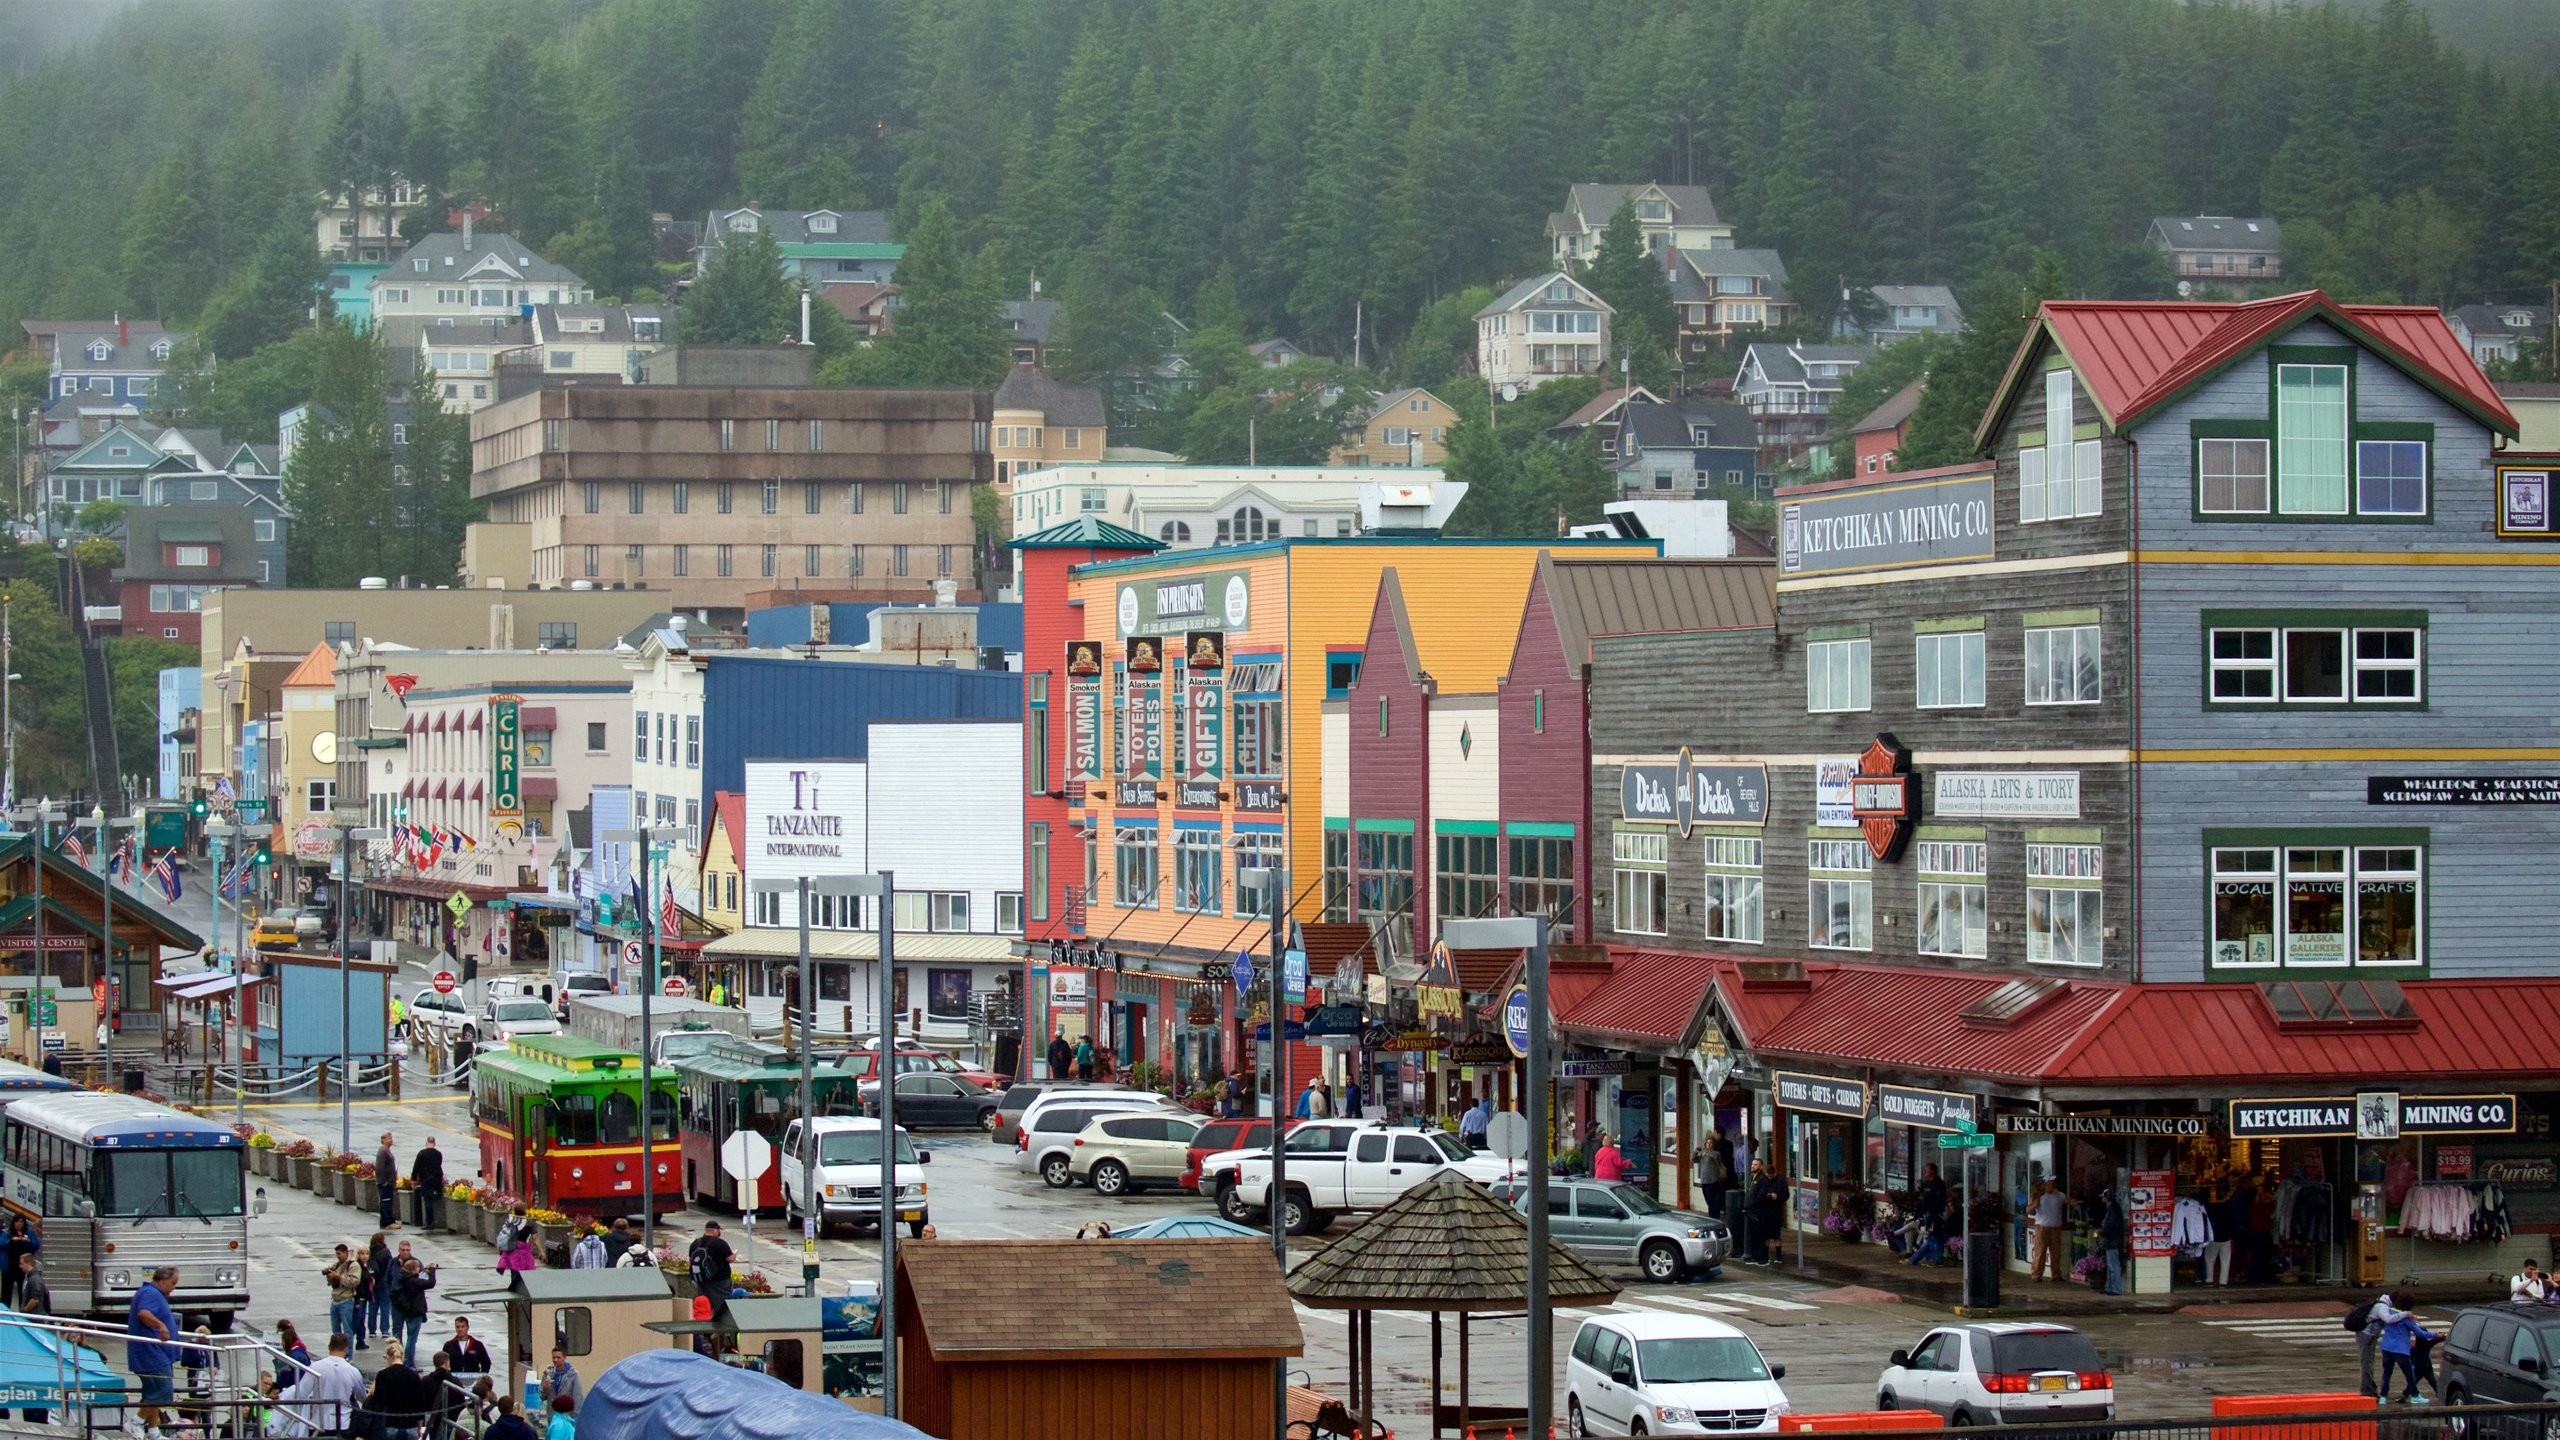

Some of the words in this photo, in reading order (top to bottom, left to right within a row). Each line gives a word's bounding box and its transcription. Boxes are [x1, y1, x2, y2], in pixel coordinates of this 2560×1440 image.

[1803, 511, 1893, 554] KETCHIKAN
[1899, 503, 1960, 544] MINING
[1965, 500, 1988, 536] CO.
[1070, 684, 1100, 692] Smoked
[1129, 681, 1161, 689] Alaskan
[1189, 677, 1223, 687] Alaskan
[399, 686, 405, 695] 2
[1076, 695, 1095, 769] SALMON
[1131, 697, 1145, 763] TOTEM
[1146, 699, 1160, 761] POLES
[1195, 690, 1217, 768] GIFTS
[500, 715, 515, 809] CURIO
[1820, 761, 1855, 787] FISHING
[1678, 772, 1691, 803] and
[1737, 775, 1744, 787] OF
[2403, 779, 2478, 790] WHALEBONE
[2494, 779, 2560, 790] SOAPSTONE
[1740, 788, 1757, 800] BEVERLY
[1940, 779, 1986, 799] ALASKA
[1991, 779, 2022, 799] ARTS
[2025, 781, 2034, 799] &
[2038, 779, 2075, 800] IVORY
[2383, 791, 2452, 801] SCRIMSHAW
[2469, 791, 2525, 801] ALASKAN
[1748, 801, 1760, 812] HILLS
[1818, 809, 1830, 820] MAIN
[1831, 810, 1854, 821] ENTRAN
[766, 815, 842, 836] TANZANITE
[766, 843, 842, 857] INTERNATIONAL
[1920, 844, 1986, 873] NATIVE
[2030, 847, 2101, 876] CRAFTS
[2215, 882, 2273, 895] LOCAL
[2289, 881, 2344, 894] NATIVE
[2359, 881, 2415, 894] CRAFTS
[47, 938, 85, 948] CENTER
[2297, 934, 2336, 942] ALASKA
[2290, 944, 2342, 952] GALLERIES
[1397, 1039, 1438, 1050] Dynasty
[1585, 1062, 1627, 1070] TANZANITE
[1781, 1081, 1807, 1100] TOTEMS
[1811, 1087, 1831, 1103] GIFTS
[1835, 1089, 1861, 1107] CURIOS
[1884, 1094, 1903, 1113] GOLD
[1903, 1098, 1935, 1117] NUGGETS
[2240, 1108, 2350, 1128] KETCHIKAN
[2405, 1105, 2473, 1125] MINING
[2477, 1105, 2506, 1124] CO.
[2013, 1116, 2107, 1133] KETCHIKAN
[2111, 1118, 2173, 1133] MINING
[2178, 1119, 2203, 1134] CO.
[2437, 1155, 2471, 1166] $19.99
[2487, 1163, 2549, 1183] Curios
